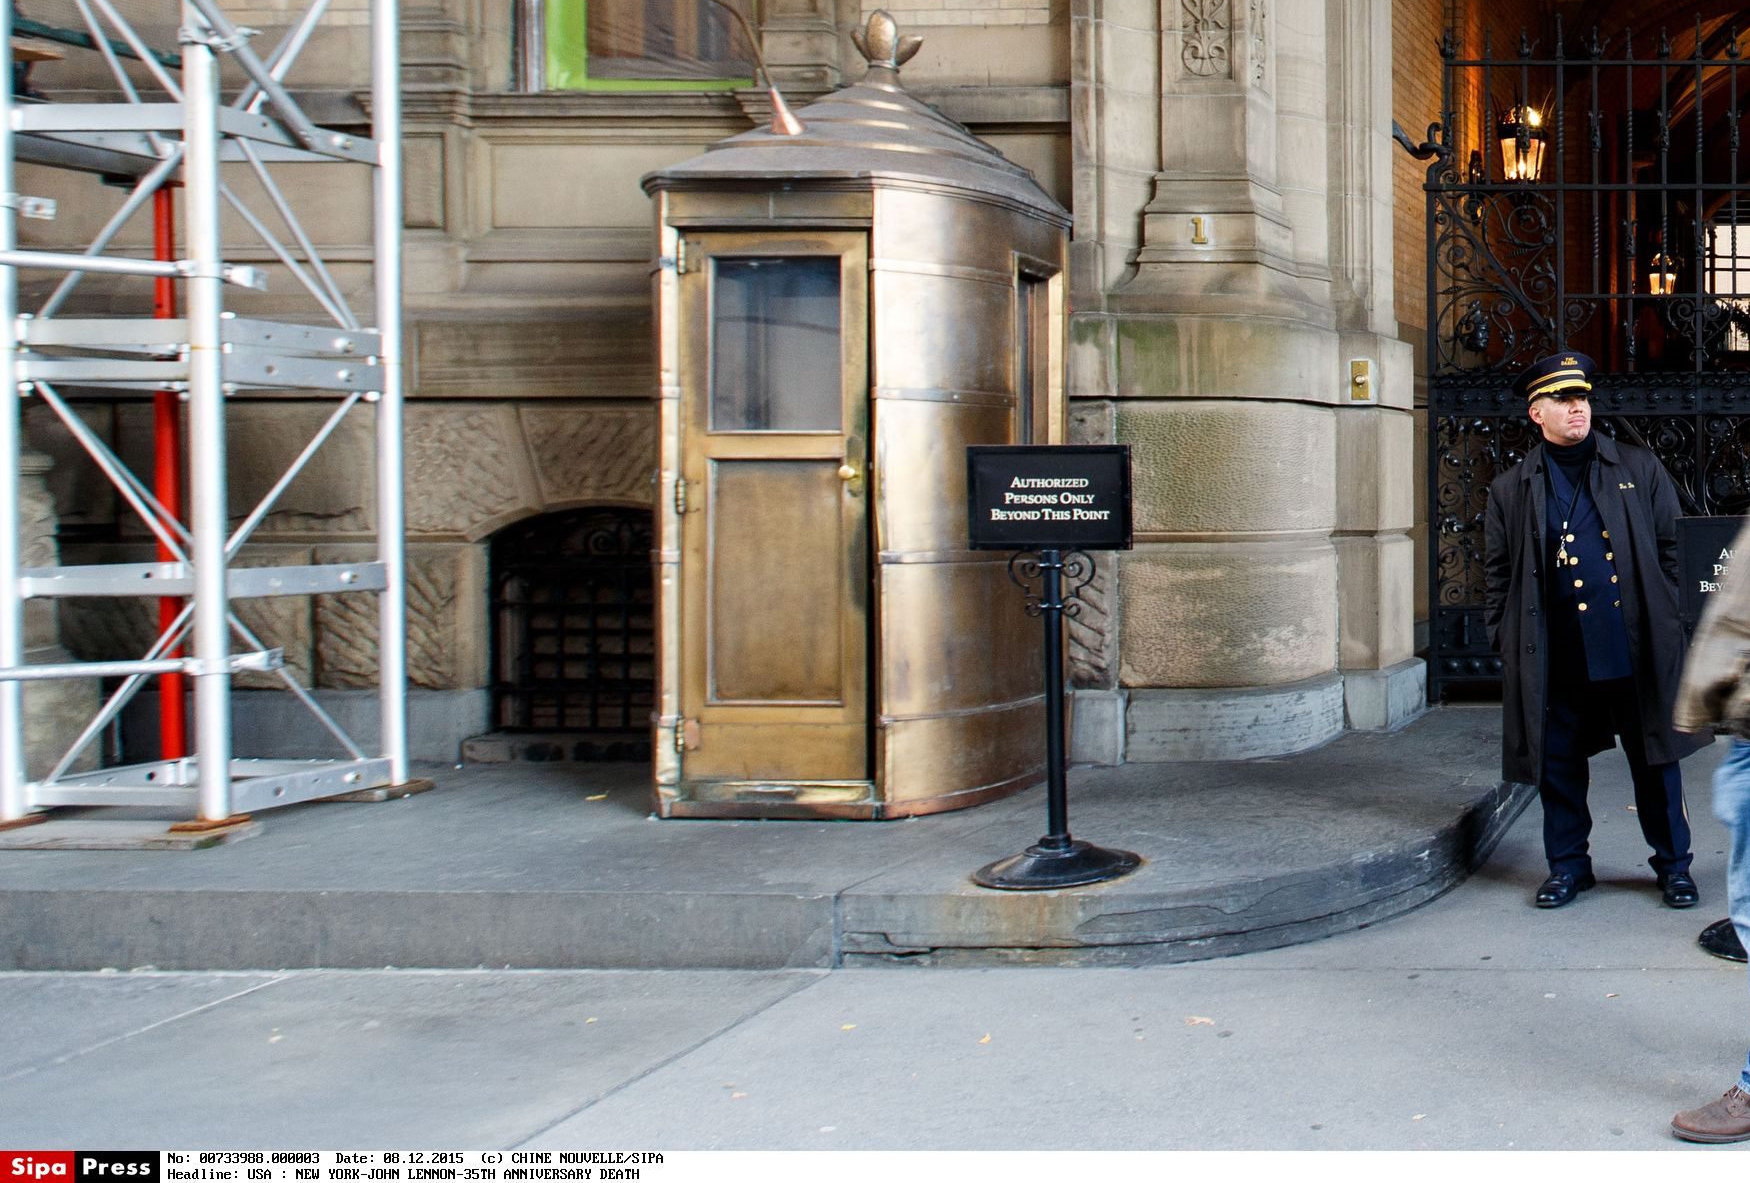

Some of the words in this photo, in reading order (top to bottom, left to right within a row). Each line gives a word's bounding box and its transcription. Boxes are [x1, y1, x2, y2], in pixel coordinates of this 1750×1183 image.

[1191, 217, 1208, 244] 1
[1010, 476, 1089, 489] AUTHORIZED
[1004, 492, 1058, 505] PERSONS
[1059, 492, 1096, 505] ONLY
[990, 508, 1041, 521] BEYOND
[1041, 508, 1071, 521] THIS
[1072, 508, 1111, 521] POINT
[1699, 580, 1726, 593] BEY
